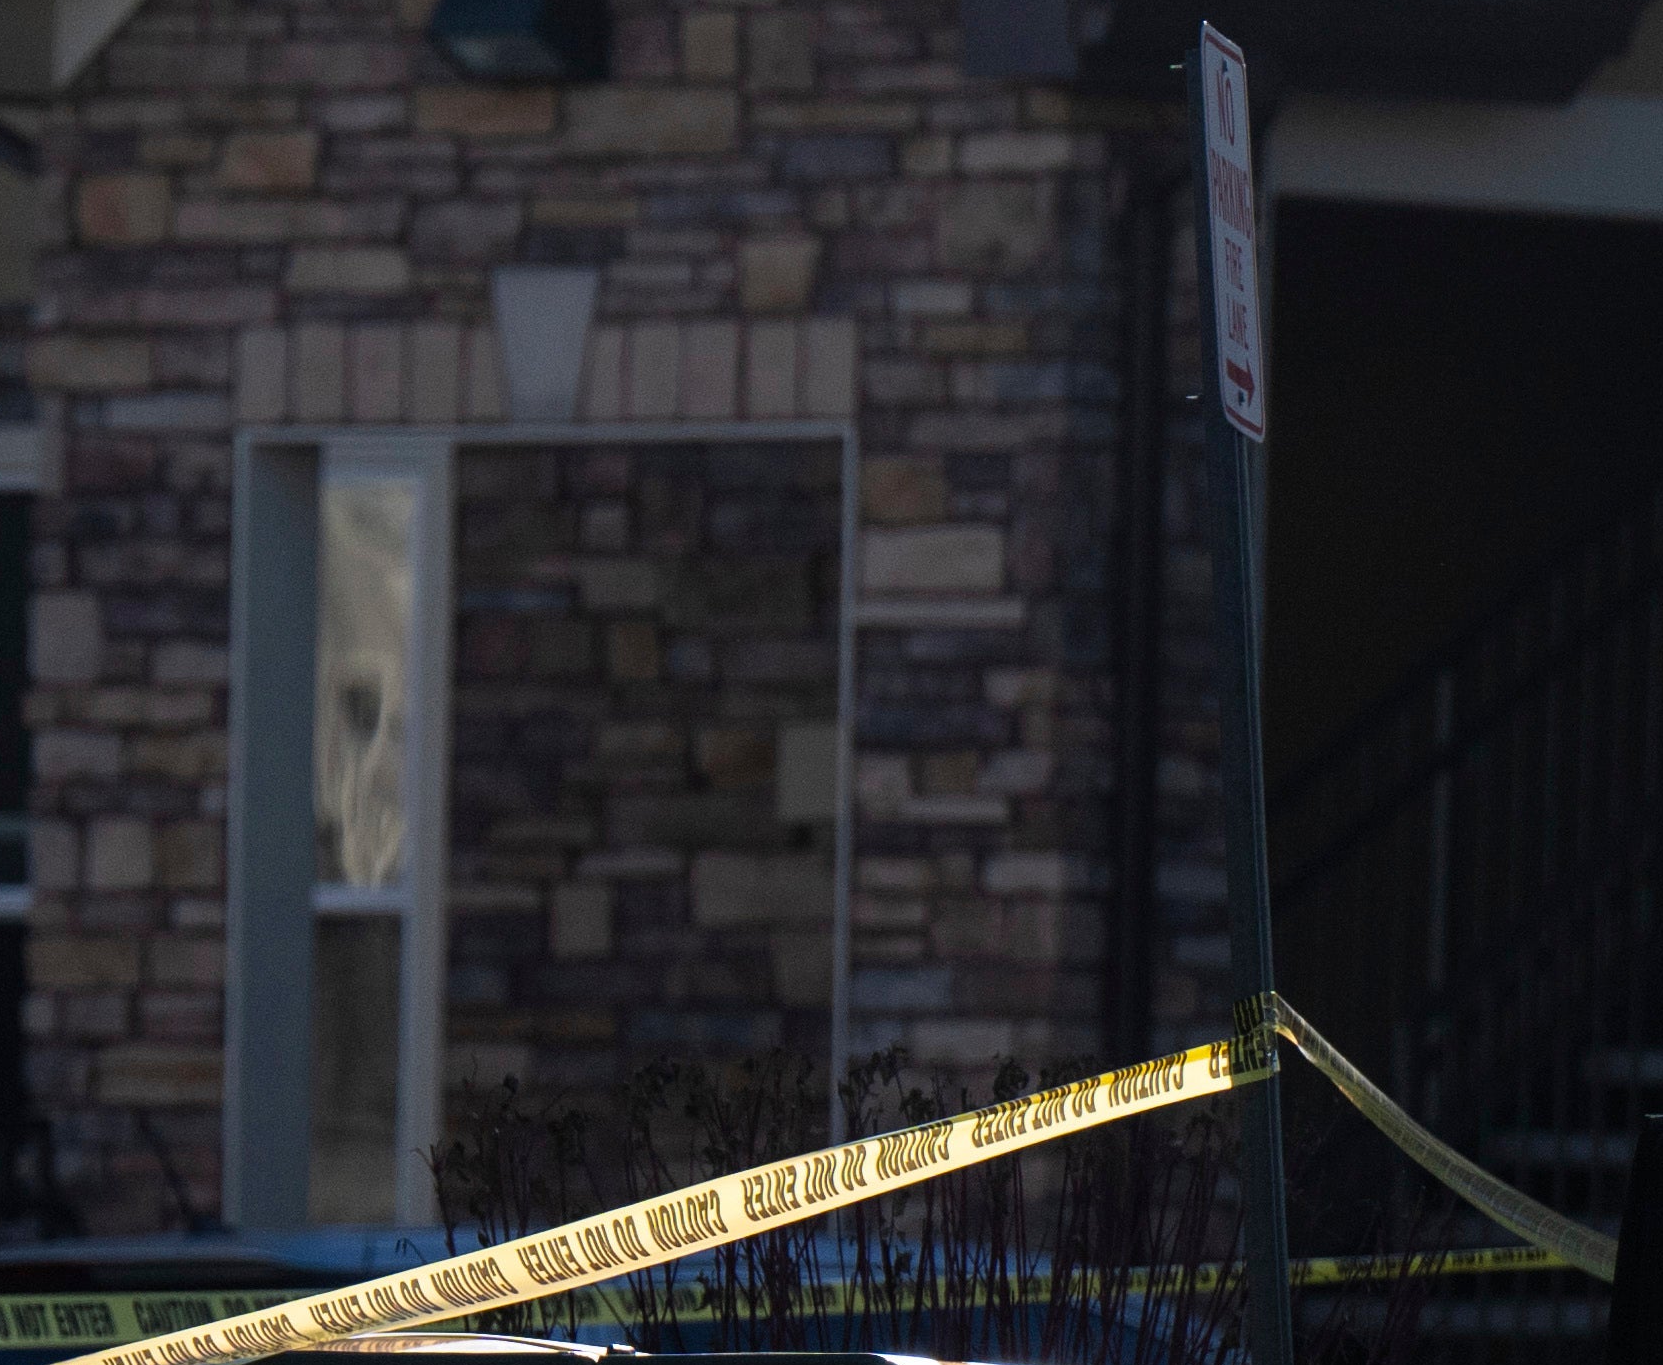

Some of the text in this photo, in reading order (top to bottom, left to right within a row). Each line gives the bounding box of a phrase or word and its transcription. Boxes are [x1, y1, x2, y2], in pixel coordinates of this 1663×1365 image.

[1216, 68, 1235, 146] NO
[973, 1050, 1185, 1148] CAUTION DO NOT ENTER
[741, 1119, 954, 1221] CAUTION DO NOT ENTER
[516, 1189, 729, 1285] CAUTION DO NOT ENTER
[364, 1286, 406, 1324] NOT
[400, 1278, 444, 1314] DO
[430, 1256, 518, 1308] CAUTION
[11, 1303, 49, 1338] NOT
[53, 1301, 115, 1337] ENTER
[308, 1295, 364, 1335] ENTER
